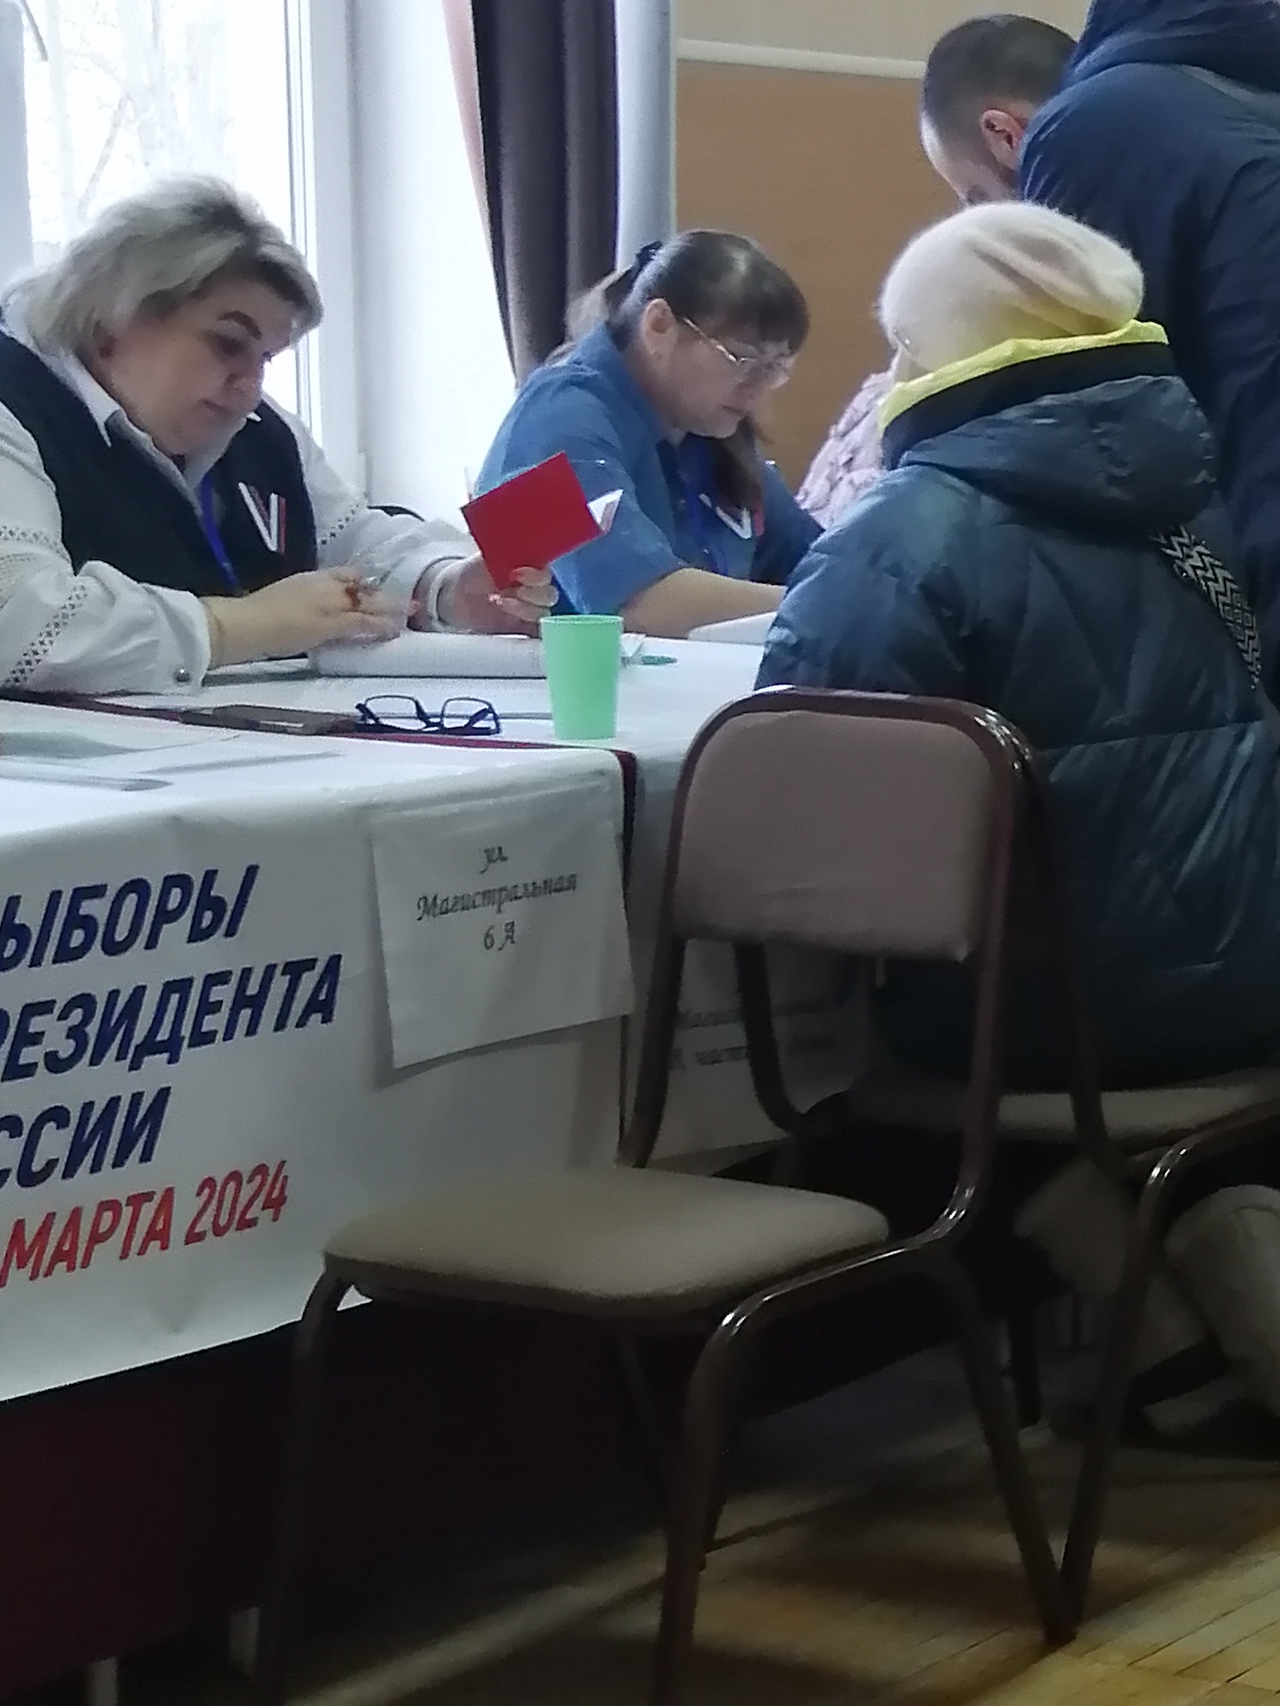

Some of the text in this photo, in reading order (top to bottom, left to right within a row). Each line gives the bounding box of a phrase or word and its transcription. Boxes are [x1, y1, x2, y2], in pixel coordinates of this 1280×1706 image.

[417, 873, 577, 921] Магистральная
[0, 954, 342, 1082] ЕЗИДЕНТА
[0, 1160, 289, 1288] МАРТА 2024
